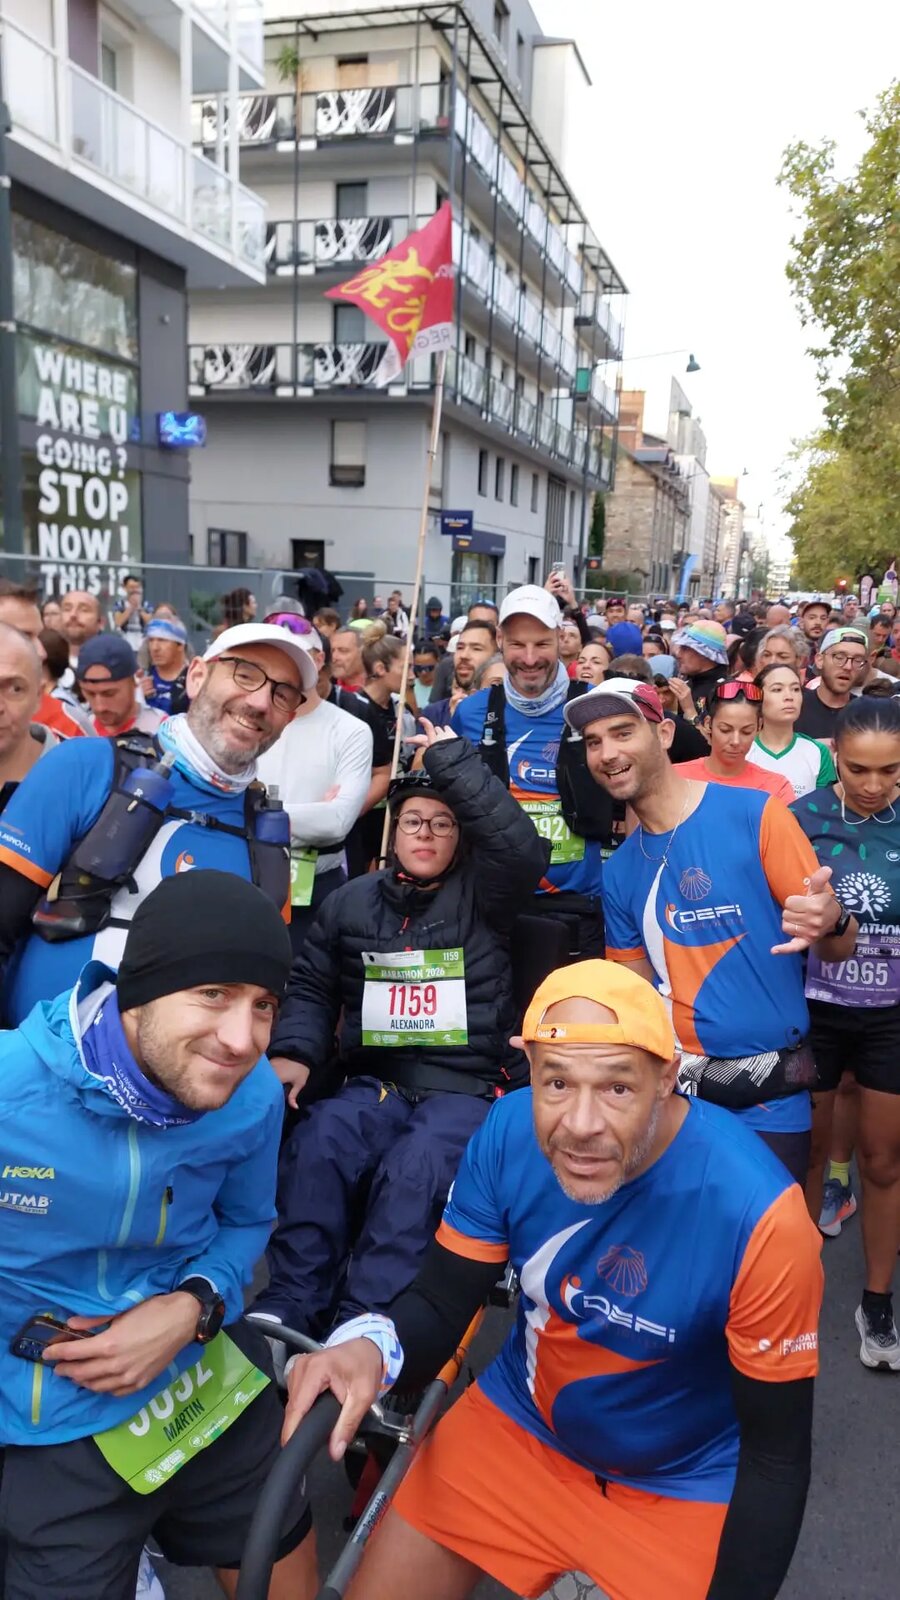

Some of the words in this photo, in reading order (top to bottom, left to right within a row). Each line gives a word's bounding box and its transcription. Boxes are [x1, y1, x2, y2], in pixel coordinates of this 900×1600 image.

[33, 345, 127, 404] WHERE
[36, 386, 101, 440] ARE
[109, 404, 128, 445] U
[38, 468, 128, 522] STOP
[40, 563, 101, 596] THIS
[443, 951, 459, 961] 1159
[381, 970, 424, 979] MARATHON
[425, 967, 445, 977] 2026
[388, 984, 438, 1017] 1159
[390, 1019, 435, 1030] ALEXANDRA
[1, 1165, 55, 1180] HOKA
[163, 1398, 206, 1442] MARTIN
